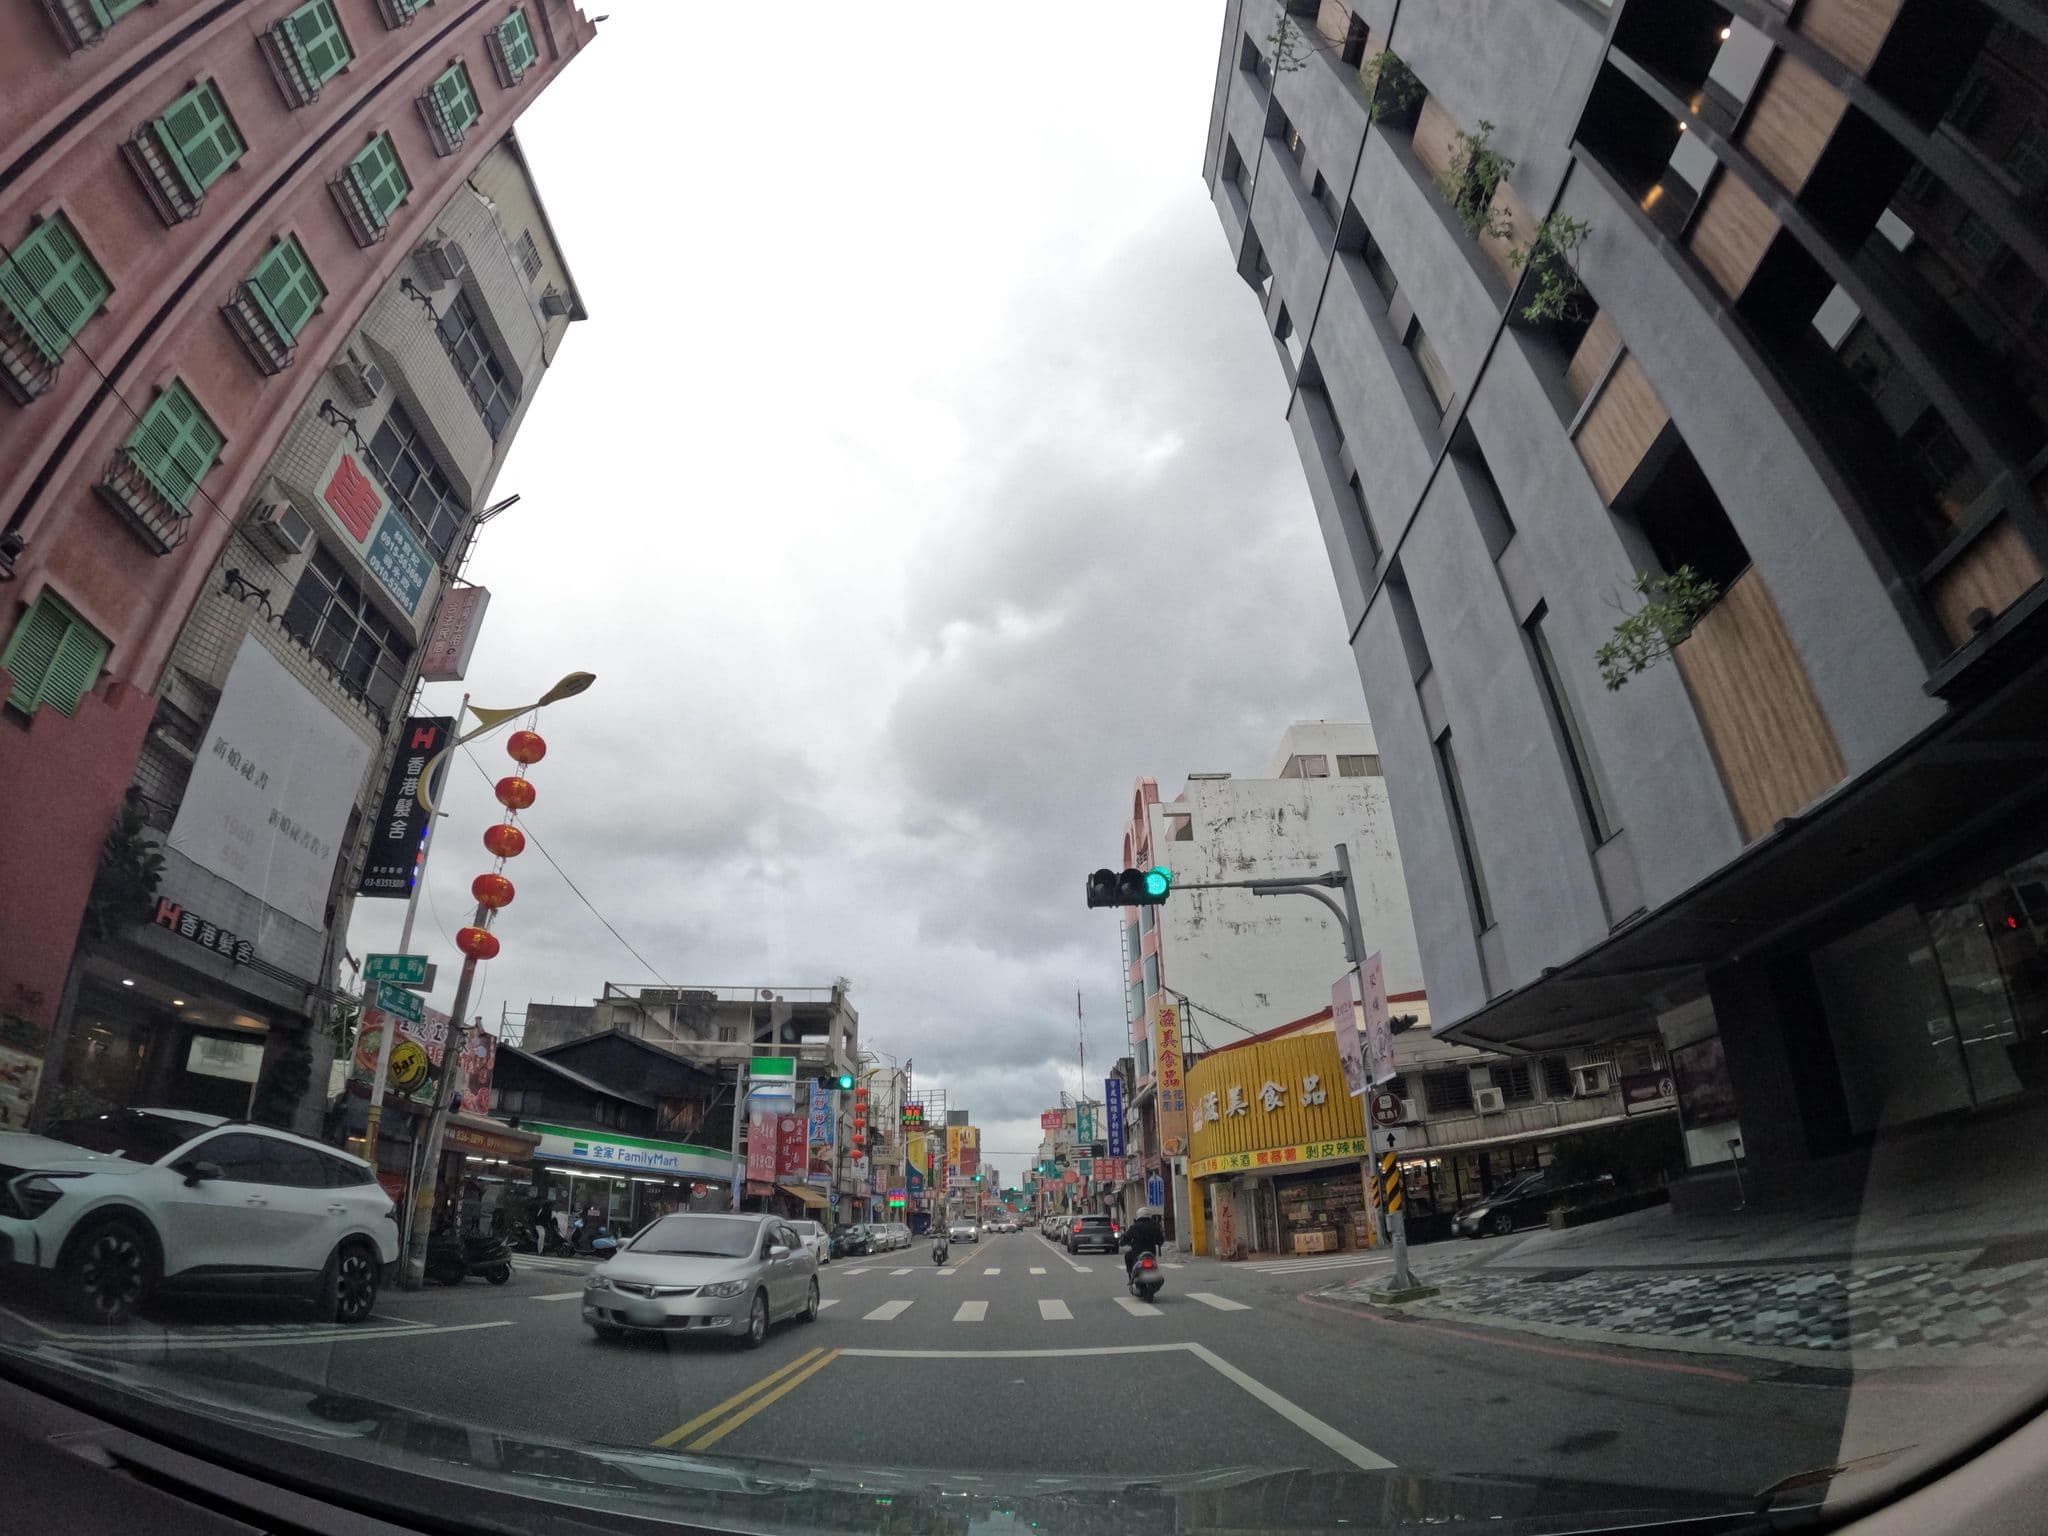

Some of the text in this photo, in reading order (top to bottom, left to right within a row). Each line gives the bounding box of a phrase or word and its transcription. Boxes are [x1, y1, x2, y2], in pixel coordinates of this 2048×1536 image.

[411, 727, 436, 749] H
[179, 911, 254, 964] 香港髮舍
[391, 1054, 417, 1076] Bar
[593, 1145, 614, 1160] 全家
[618, 1148, 679, 1168] FamilyMart
[1305, 1138, 1367, 1160] 剝皮辣椒
[1220, 1153, 1252, 1170] 小米酒
